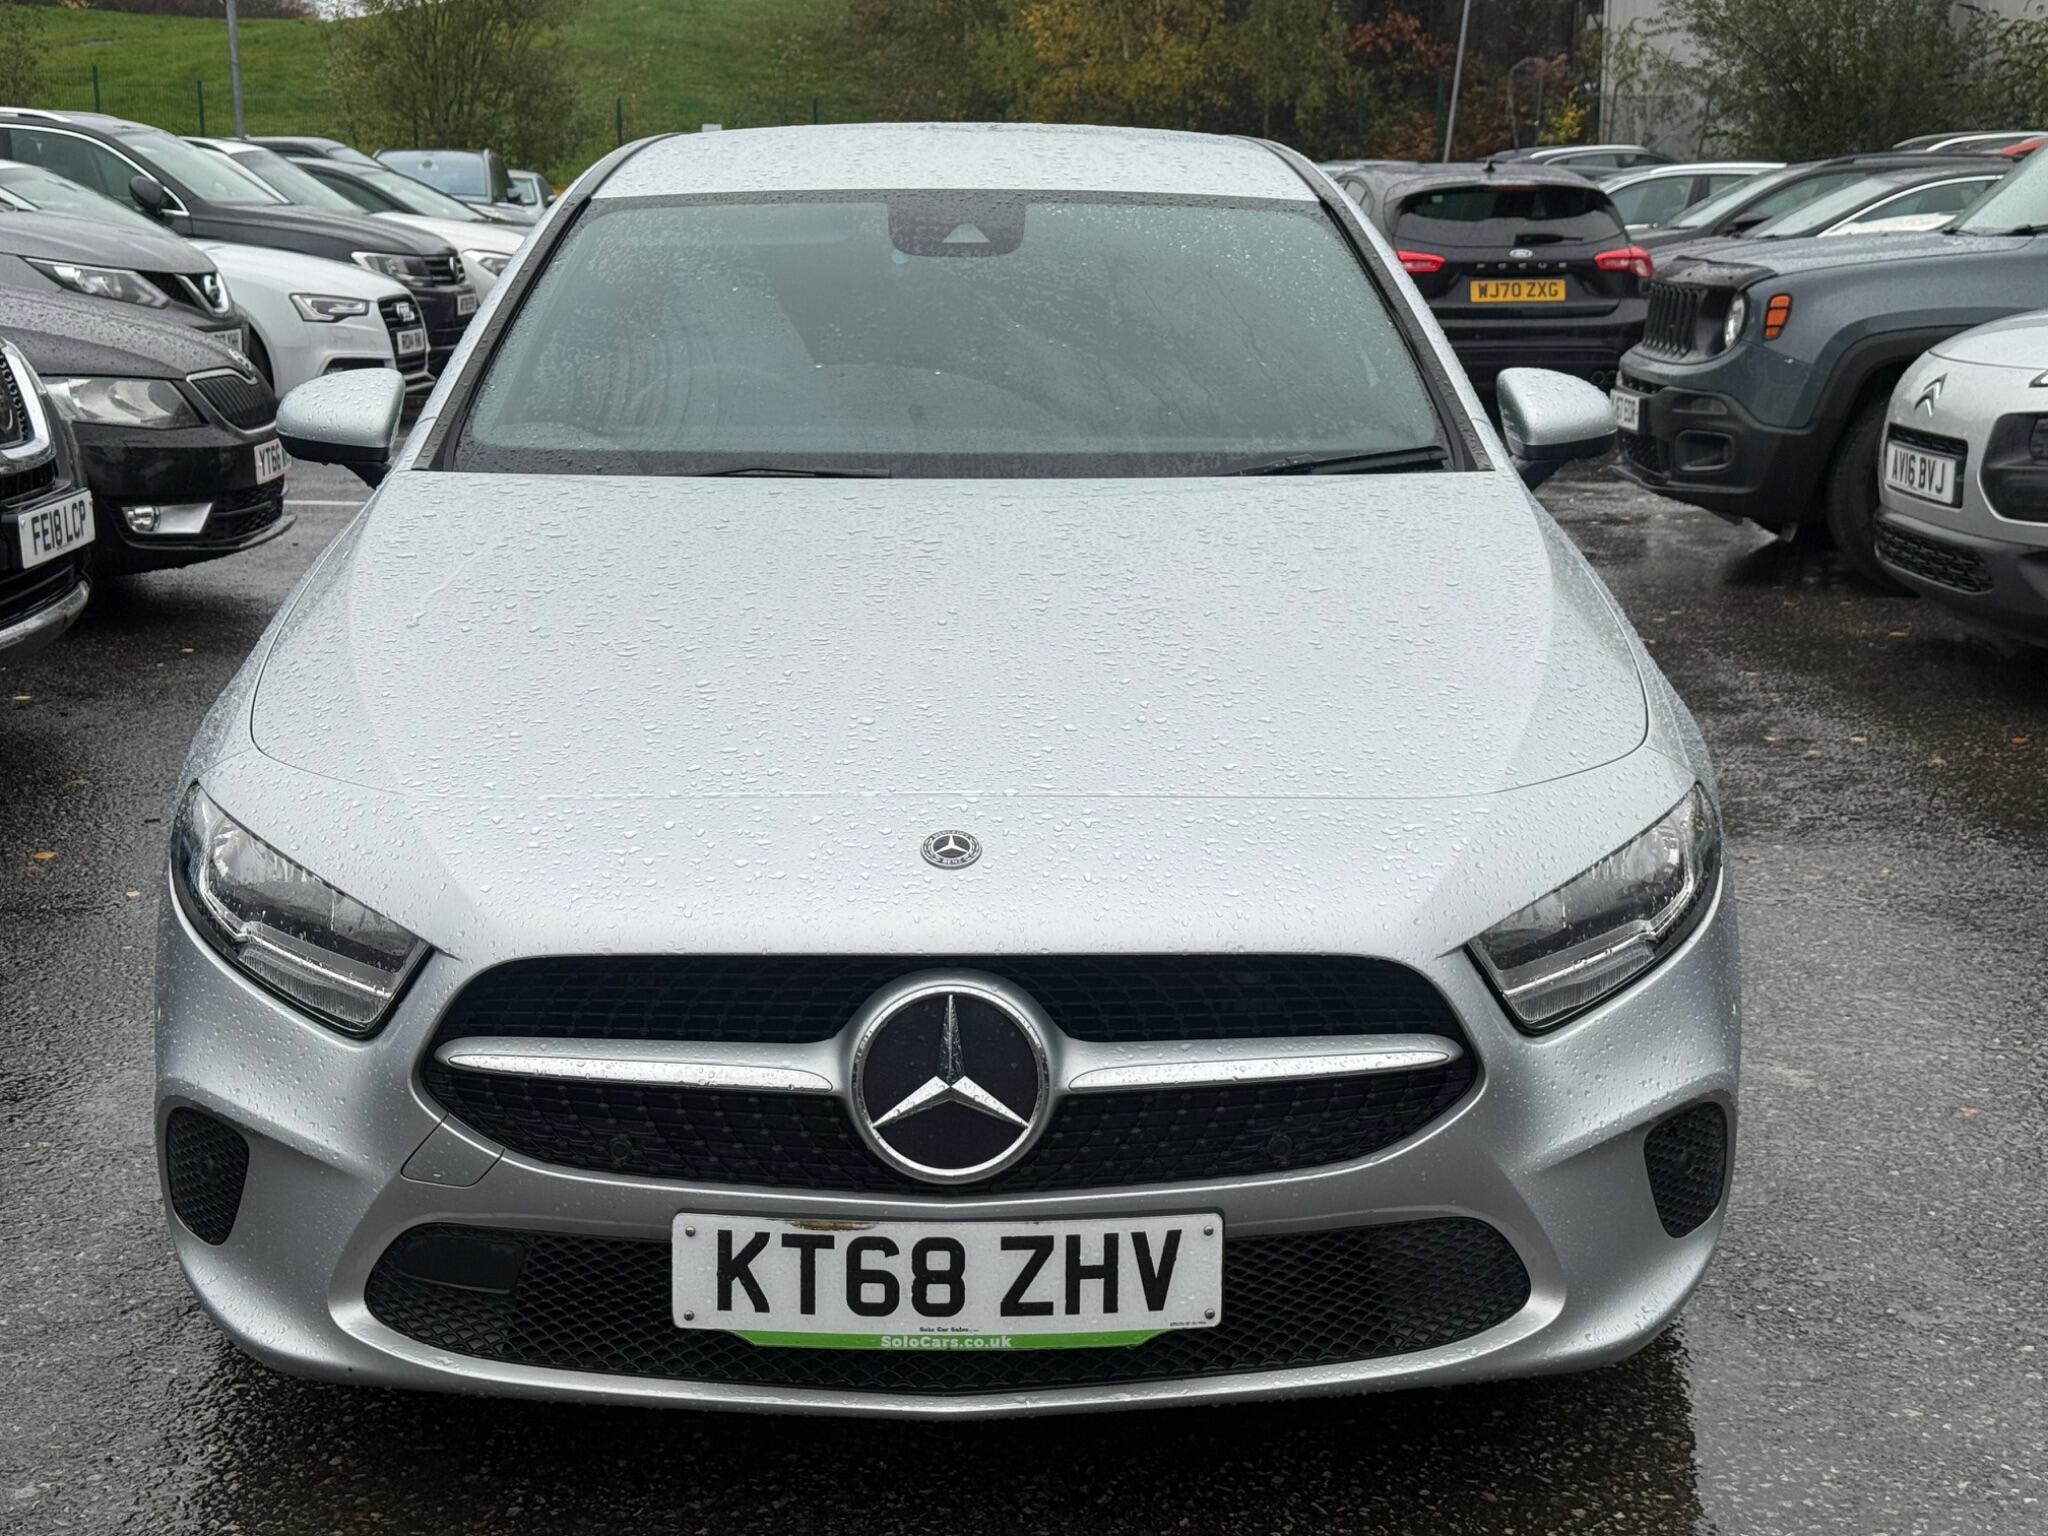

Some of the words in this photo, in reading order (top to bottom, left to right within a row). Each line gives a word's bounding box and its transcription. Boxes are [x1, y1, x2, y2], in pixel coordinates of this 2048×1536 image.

[1478, 282, 1522, 299] WJ70
[1526, 282, 1559, 298] ZXG
[258, 443, 281, 477] YT66
[1891, 449, 1916, 487] AV16
[1918, 457, 1946, 495] BVJ
[31, 509, 63, 556] FE18
[63, 500, 86, 543] LCP
[717, 1229, 966, 1318] KT68
[1000, 1229, 1183, 1317] ZHV
[880, 1335, 1013, 1348] SoloCars.co.uk
